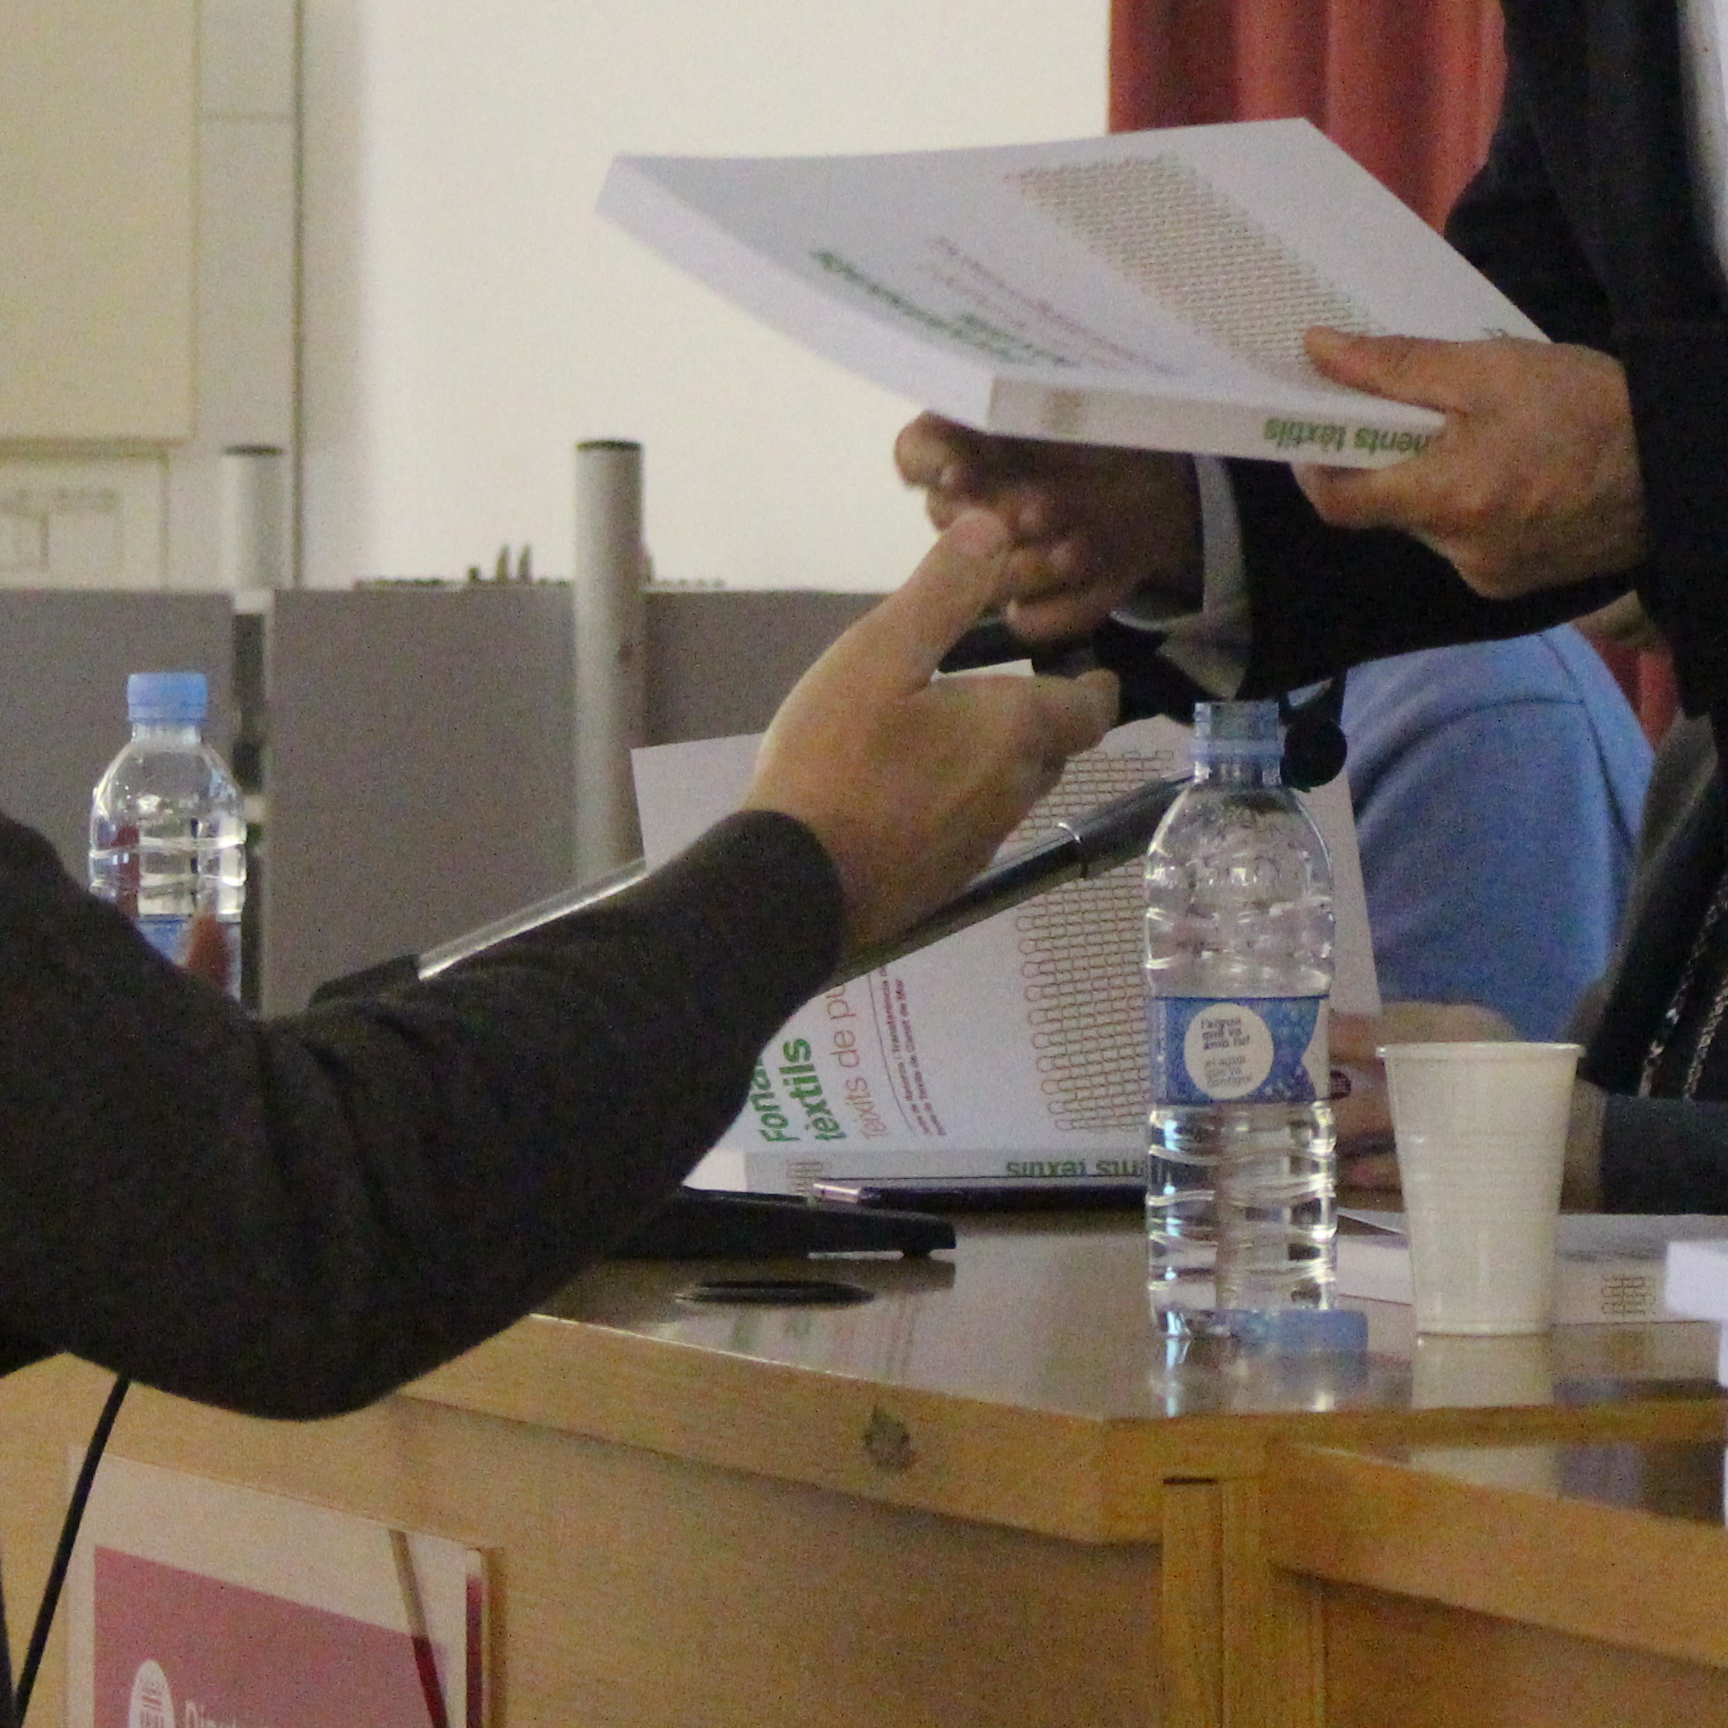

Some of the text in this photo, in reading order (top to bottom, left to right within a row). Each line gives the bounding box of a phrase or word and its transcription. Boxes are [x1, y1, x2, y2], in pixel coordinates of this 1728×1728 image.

[780, 1038, 847, 1141] tèxtils
[831, 1030, 861, 1068] de
[750, 1056, 800, 1141] Fona
